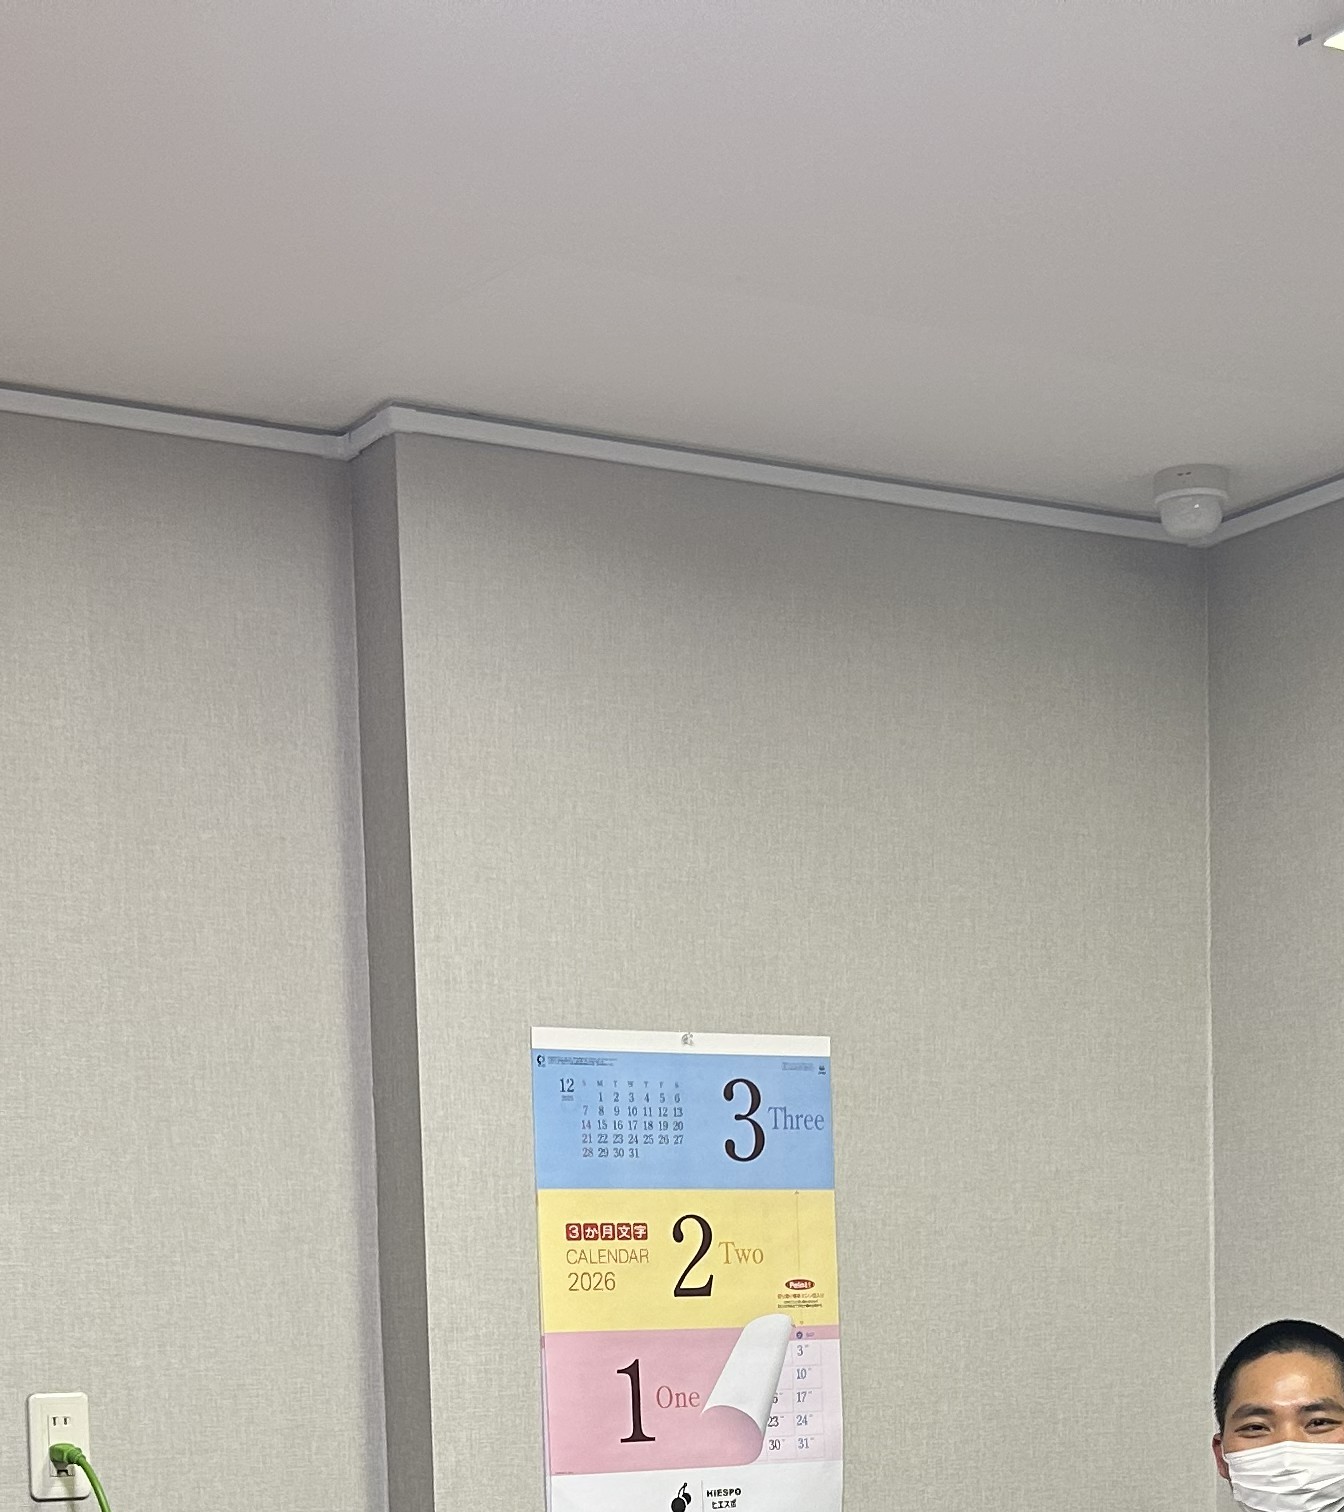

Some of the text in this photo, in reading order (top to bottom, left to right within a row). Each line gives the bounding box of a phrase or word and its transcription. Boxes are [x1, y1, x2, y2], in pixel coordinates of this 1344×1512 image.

[560, 1078, 575, 1093] 12
[599, 1092, 681, 1103] 1 2 3 4 5 6
[583, 1105, 683, 1118] 7 8 9 10 11 12 13
[582, 1120, 684, 1131] 14 15 16 17 18 19 20
[723, 1078, 825, 1162] 3 Three
[582, 1134, 684, 1145] 21 22 23 24 25 26 27
[582, 1148, 639, 1158] 28 29 30 31
[567, 1223, 648, 1240] 3か月文字
[566, 1248, 649, 1265] CALENDAR
[672, 1214, 764, 1297] 2 Two
[568, 1272, 616, 1291] 2026
[797, 1345, 803, 1356] 3
[796, 1368, 807, 1380] 10
[617, 1358, 700, 1443] 1 One
[796, 1391, 807, 1403] 17
[767, 1415, 808, 1427] 23 24
[769, 1438, 809, 1450] 30 31
[706, 1488, 741, 1497] HIESPO
